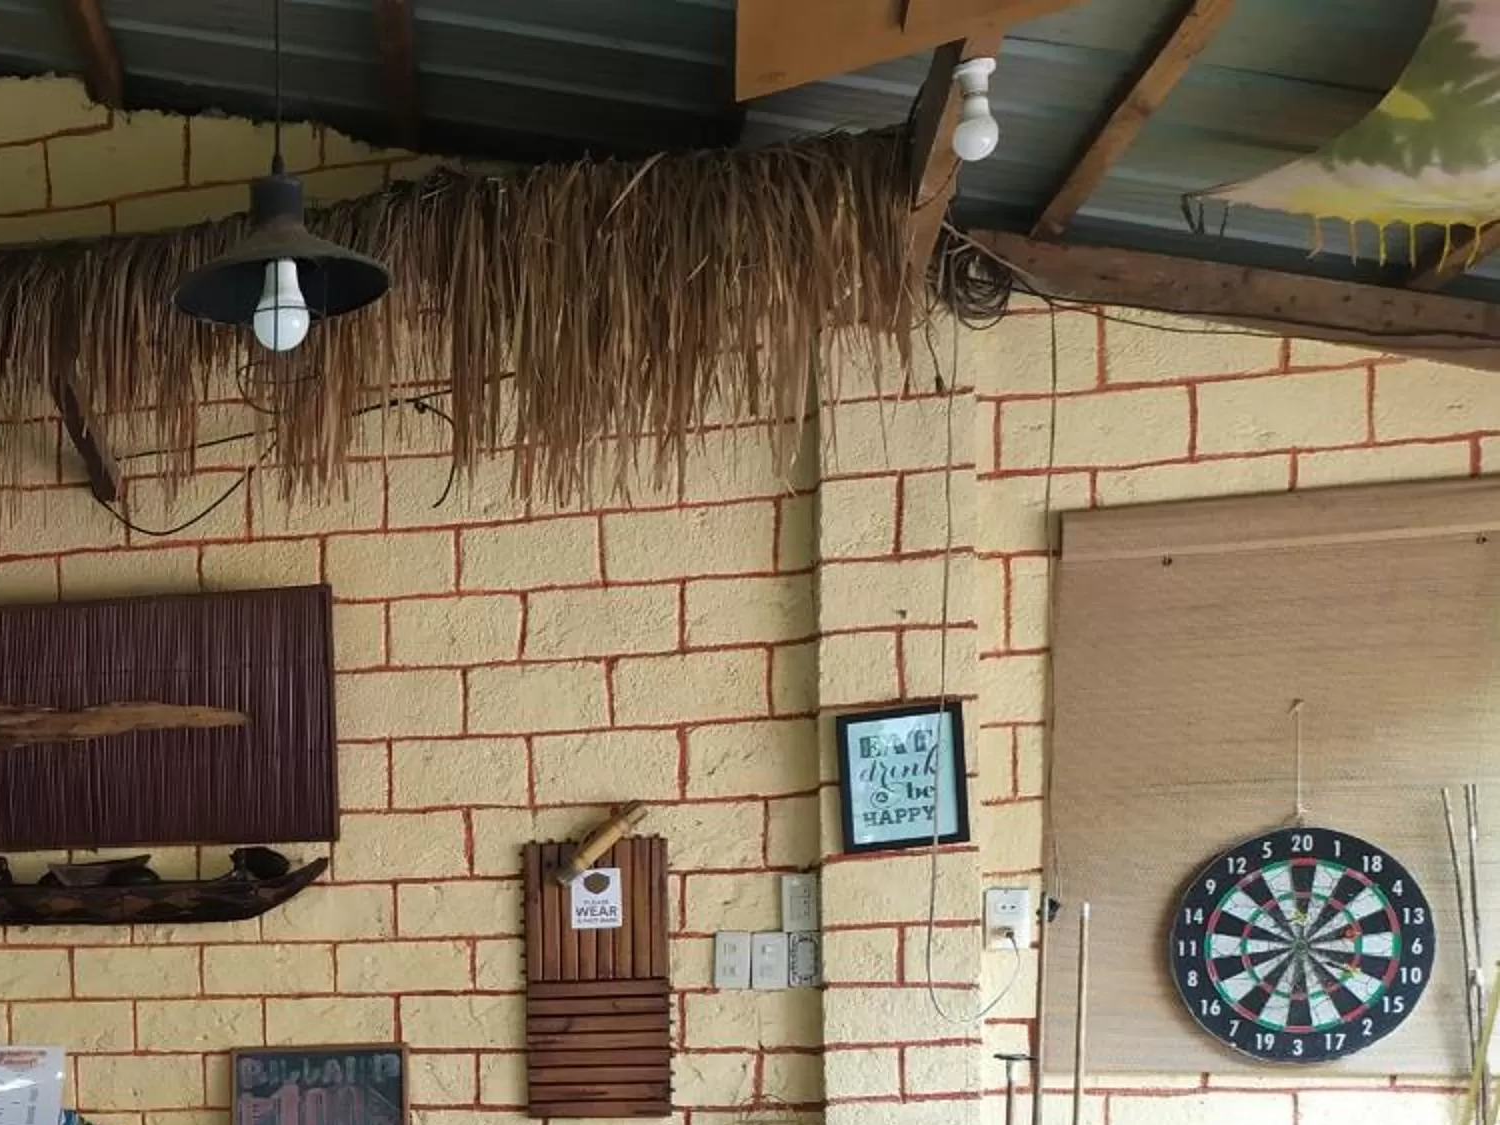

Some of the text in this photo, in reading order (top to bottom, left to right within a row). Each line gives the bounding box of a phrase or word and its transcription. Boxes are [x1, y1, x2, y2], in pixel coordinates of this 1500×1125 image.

[906, 781, 937, 800] be
[862, 805, 936, 828] HAPPY
[1262, 841, 1272, 859] 5
[1292, 835, 1313, 852] 20
[1334, 840, 1341, 857] 1
[1227, 857, 1247, 874] 12
[1363, 856, 1383, 872] 18
[1205, 879, 1216, 895] 9
[1392, 879, 1403, 897] 4
[576, 905, 617, 917] WEAR
[1184, 908, 1204, 925] 14
[1403, 908, 1425, 925] 13
[1178, 940, 1197, 956] 11
[1411, 938, 1423, 955] 6
[1187, 970, 1198, 987] 8
[1400, 967, 1422, 983] 10
[1201, 999, 1222, 1016] 16
[1383, 995, 1405, 1013] 15
[1229, 1020, 1240, 1037] 7
[1362, 1018, 1373, 1036] 2
[1256, 1034, 1276, 1051] 19
[1293, 1038, 1303, 1056] 3
[1325, 1033, 1347, 1050] 17
